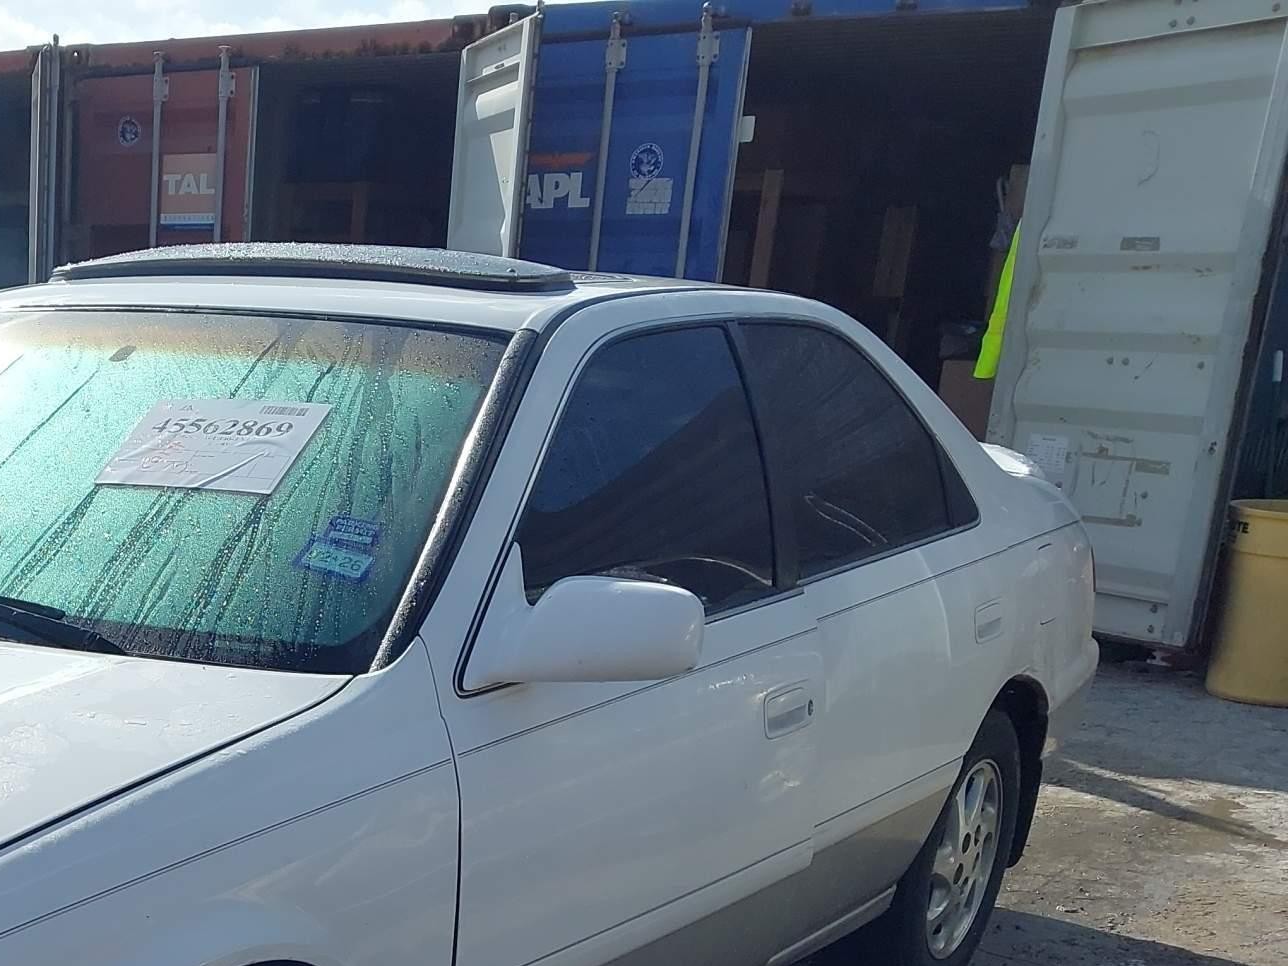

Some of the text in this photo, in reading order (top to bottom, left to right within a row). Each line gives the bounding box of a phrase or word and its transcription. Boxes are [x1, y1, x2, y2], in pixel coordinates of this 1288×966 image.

[163, 173, 216, 195] TAL
[526, 172, 591, 209] APL
[151, 416, 295, 438] 45562869
